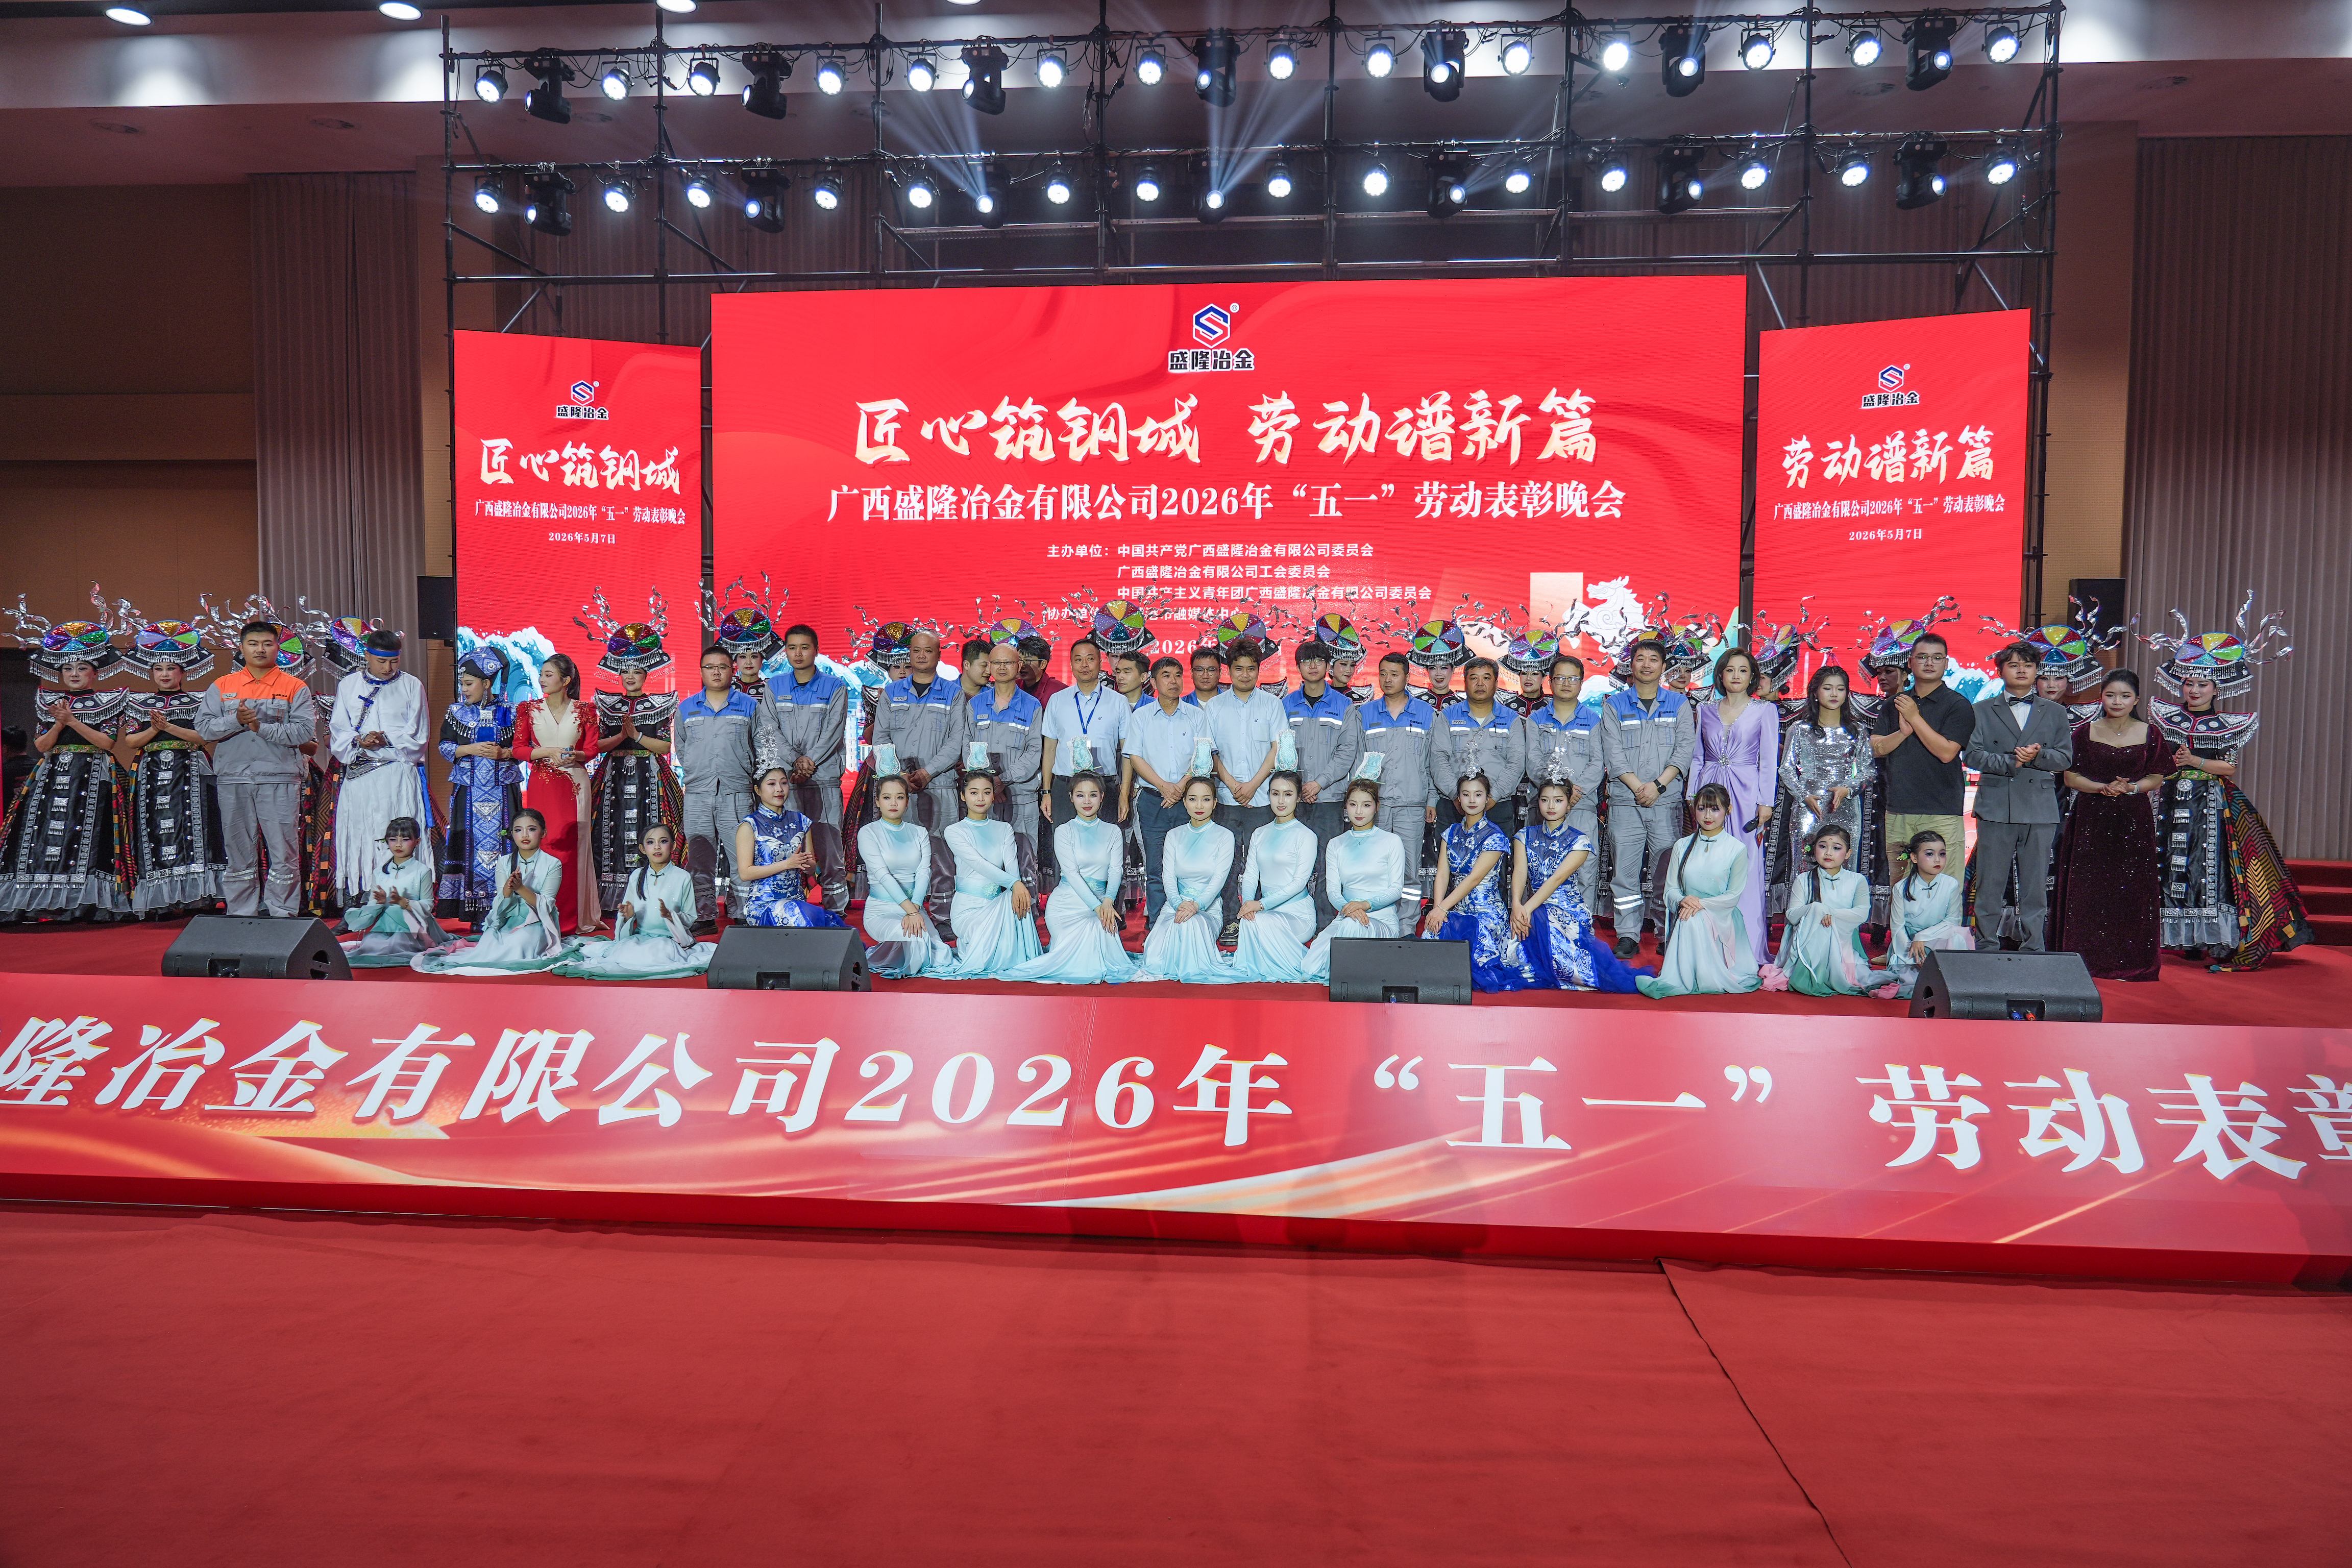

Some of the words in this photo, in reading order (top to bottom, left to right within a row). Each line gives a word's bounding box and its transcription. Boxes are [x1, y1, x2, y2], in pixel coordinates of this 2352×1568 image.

[1168, 348, 1255, 373] 盛隆冶金
[1862, 391, 1920, 408] 盛隆冶金
[556, 405, 609, 420] 盛隆冶金
[855, 394, 1201, 464] 匠心筑钢城
[1247, 387, 1597, 465] 劳动谱新篇
[1782, 425, 1994, 488] 劳动谱新篇
[480, 438, 680, 495] 匠心筑钢城
[549, 531, 616, 544] 2026年5月7日
[1849, 528, 1922, 541] 2026年5月7日
[1117, 565, 1331, 579] 广西盛隆冶金有限公司工会委员会
